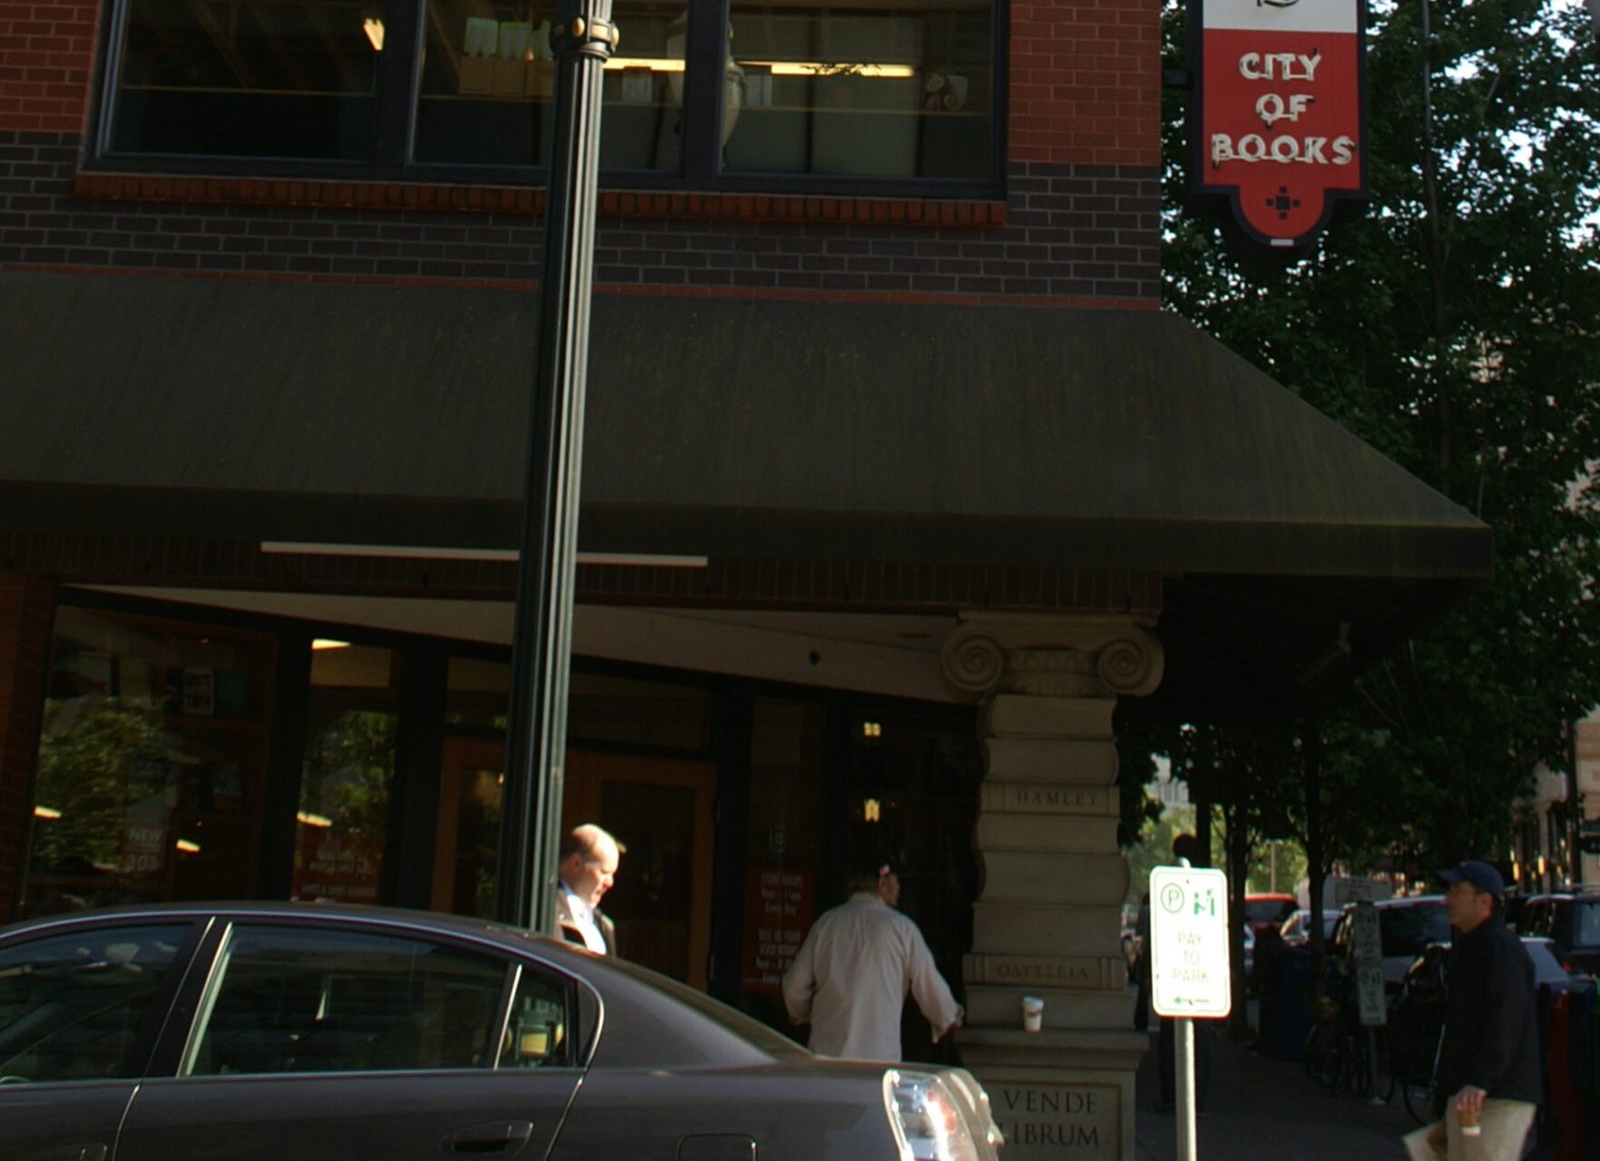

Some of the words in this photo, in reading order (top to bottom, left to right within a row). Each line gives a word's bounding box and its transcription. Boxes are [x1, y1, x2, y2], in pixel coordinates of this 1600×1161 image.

[1239, 52, 1322, 81] CITY
[1256, 93, 1314, 122] OF
[1211, 133, 1357, 166] BOOKS
[1016, 790, 1098, 807] HAMLET
[1177, 928, 1203, 946] PAY
[1182, 949, 1201, 966] TO
[1170, 966, 1210, 983] PARK
[1003, 1089, 1097, 1114] VENDE
